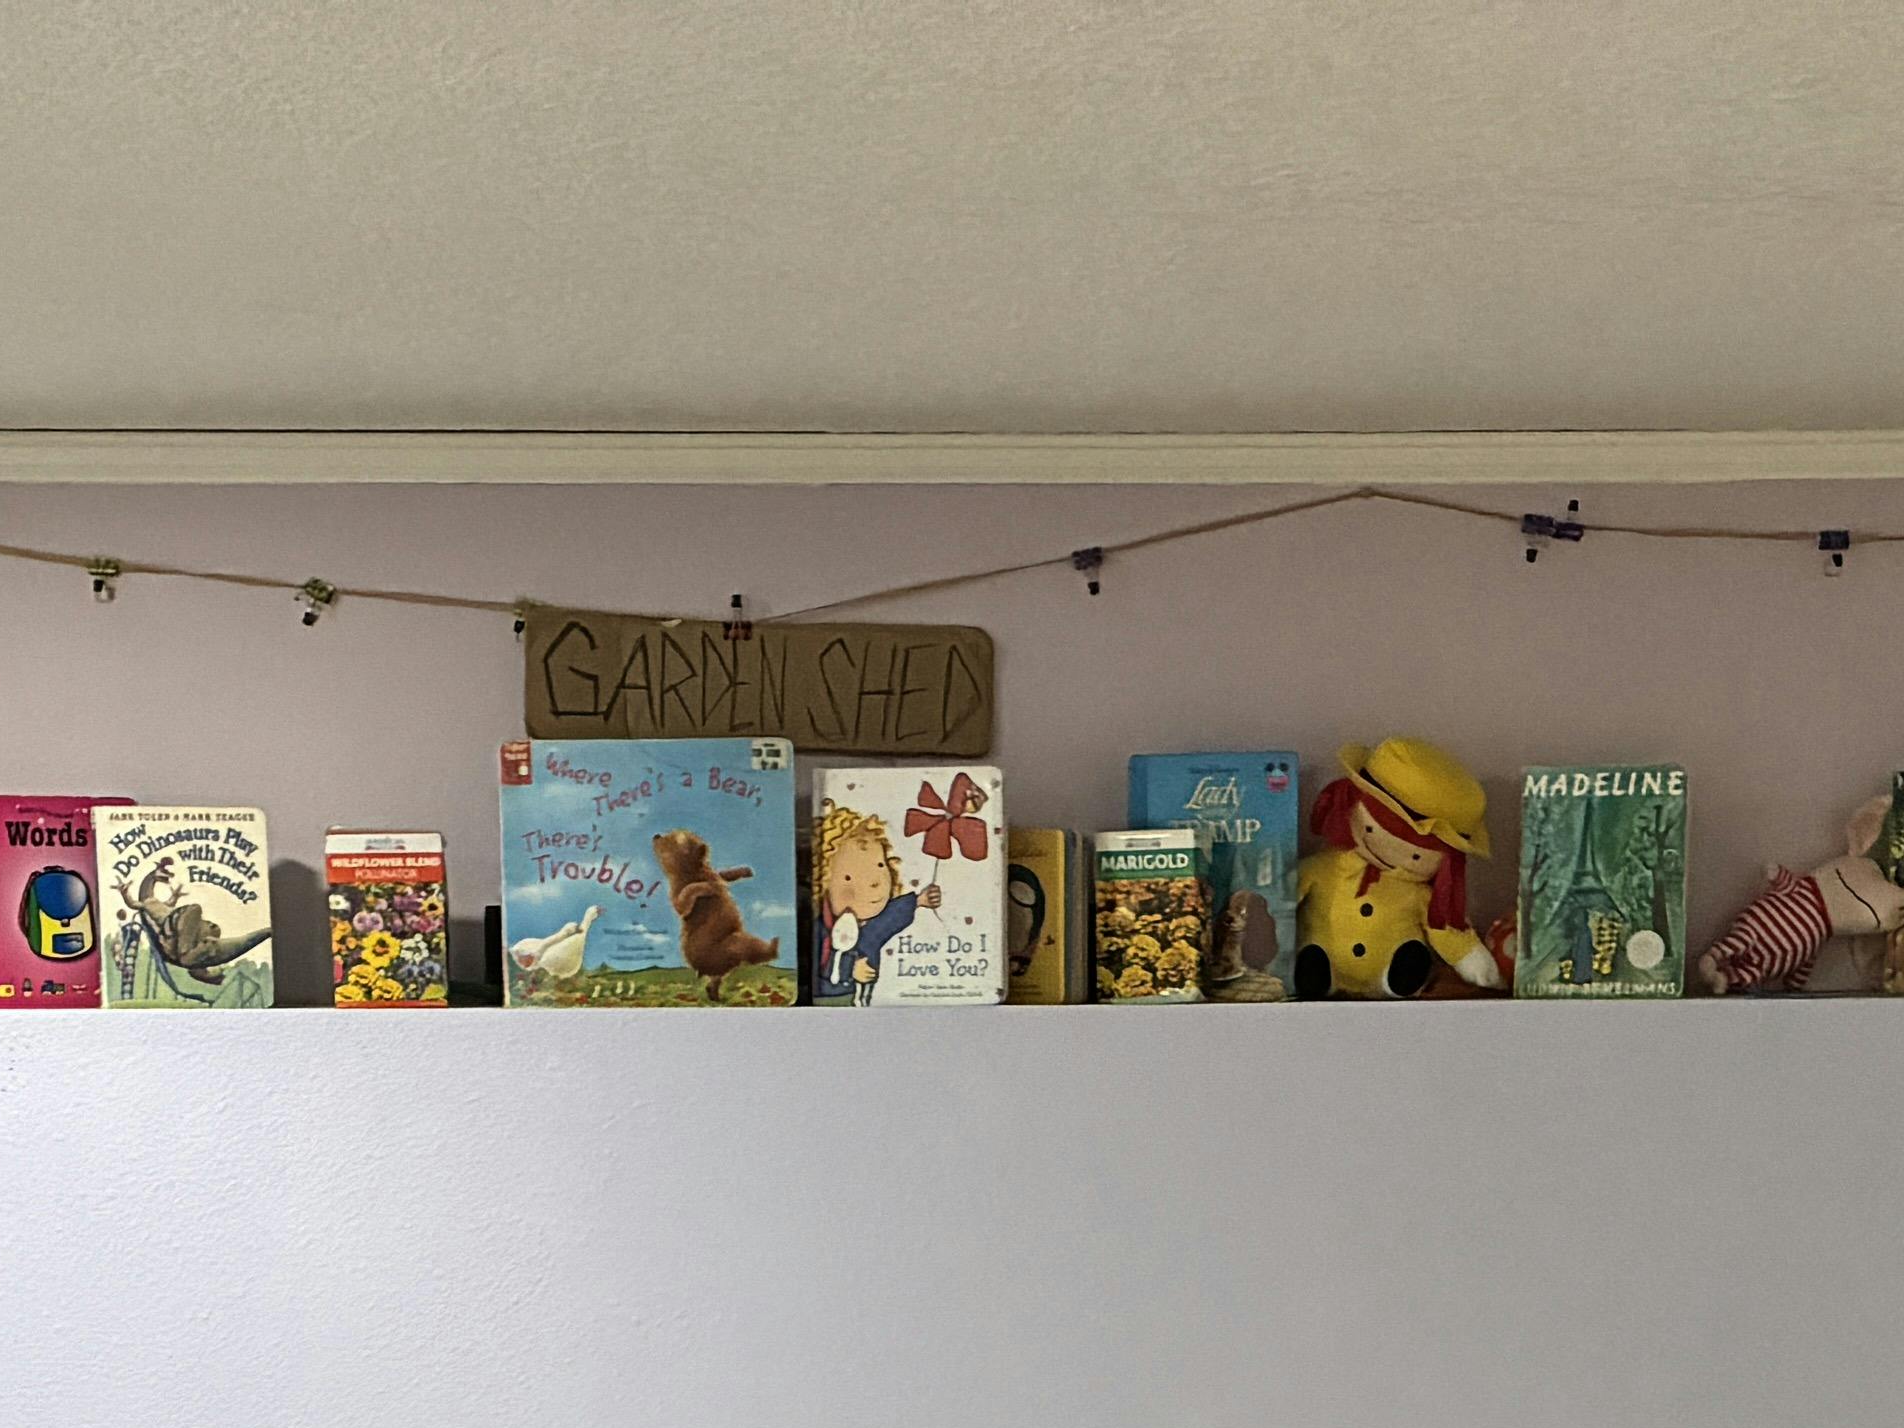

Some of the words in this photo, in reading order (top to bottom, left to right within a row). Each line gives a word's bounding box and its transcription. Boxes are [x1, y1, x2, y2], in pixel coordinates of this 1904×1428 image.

[543, 621, 787, 732] GARDEN
[807, 637, 982, 744] SHED
[545, 752, 613, 788] Where
[1522, 770, 1684, 797] MADELINE
[592, 766, 665, 816] There's
[680, 772, 693, 788] a
[707, 766, 763, 808] Bear,
[5, 821, 88, 847] Words
[110, 824, 147, 854] How
[520, 823, 604, 853] There's
[114, 855, 140, 878] Do
[135, 827, 220, 859] Dinosaurs
[223, 827, 259, 857] Play
[177, 844, 216, 862] with
[218, 846, 260, 881] Their
[1101, 852, 1190, 871] MARIGOLD
[187, 865, 258, 904] Friends?
[531, 854, 662, 909] Trouble!
[897, 935, 941, 954] How
[947, 935, 973, 954] Do
[979, 933, 987, 953] I
[897, 959, 940, 977] Love
[946, 959, 989, 977] You?
